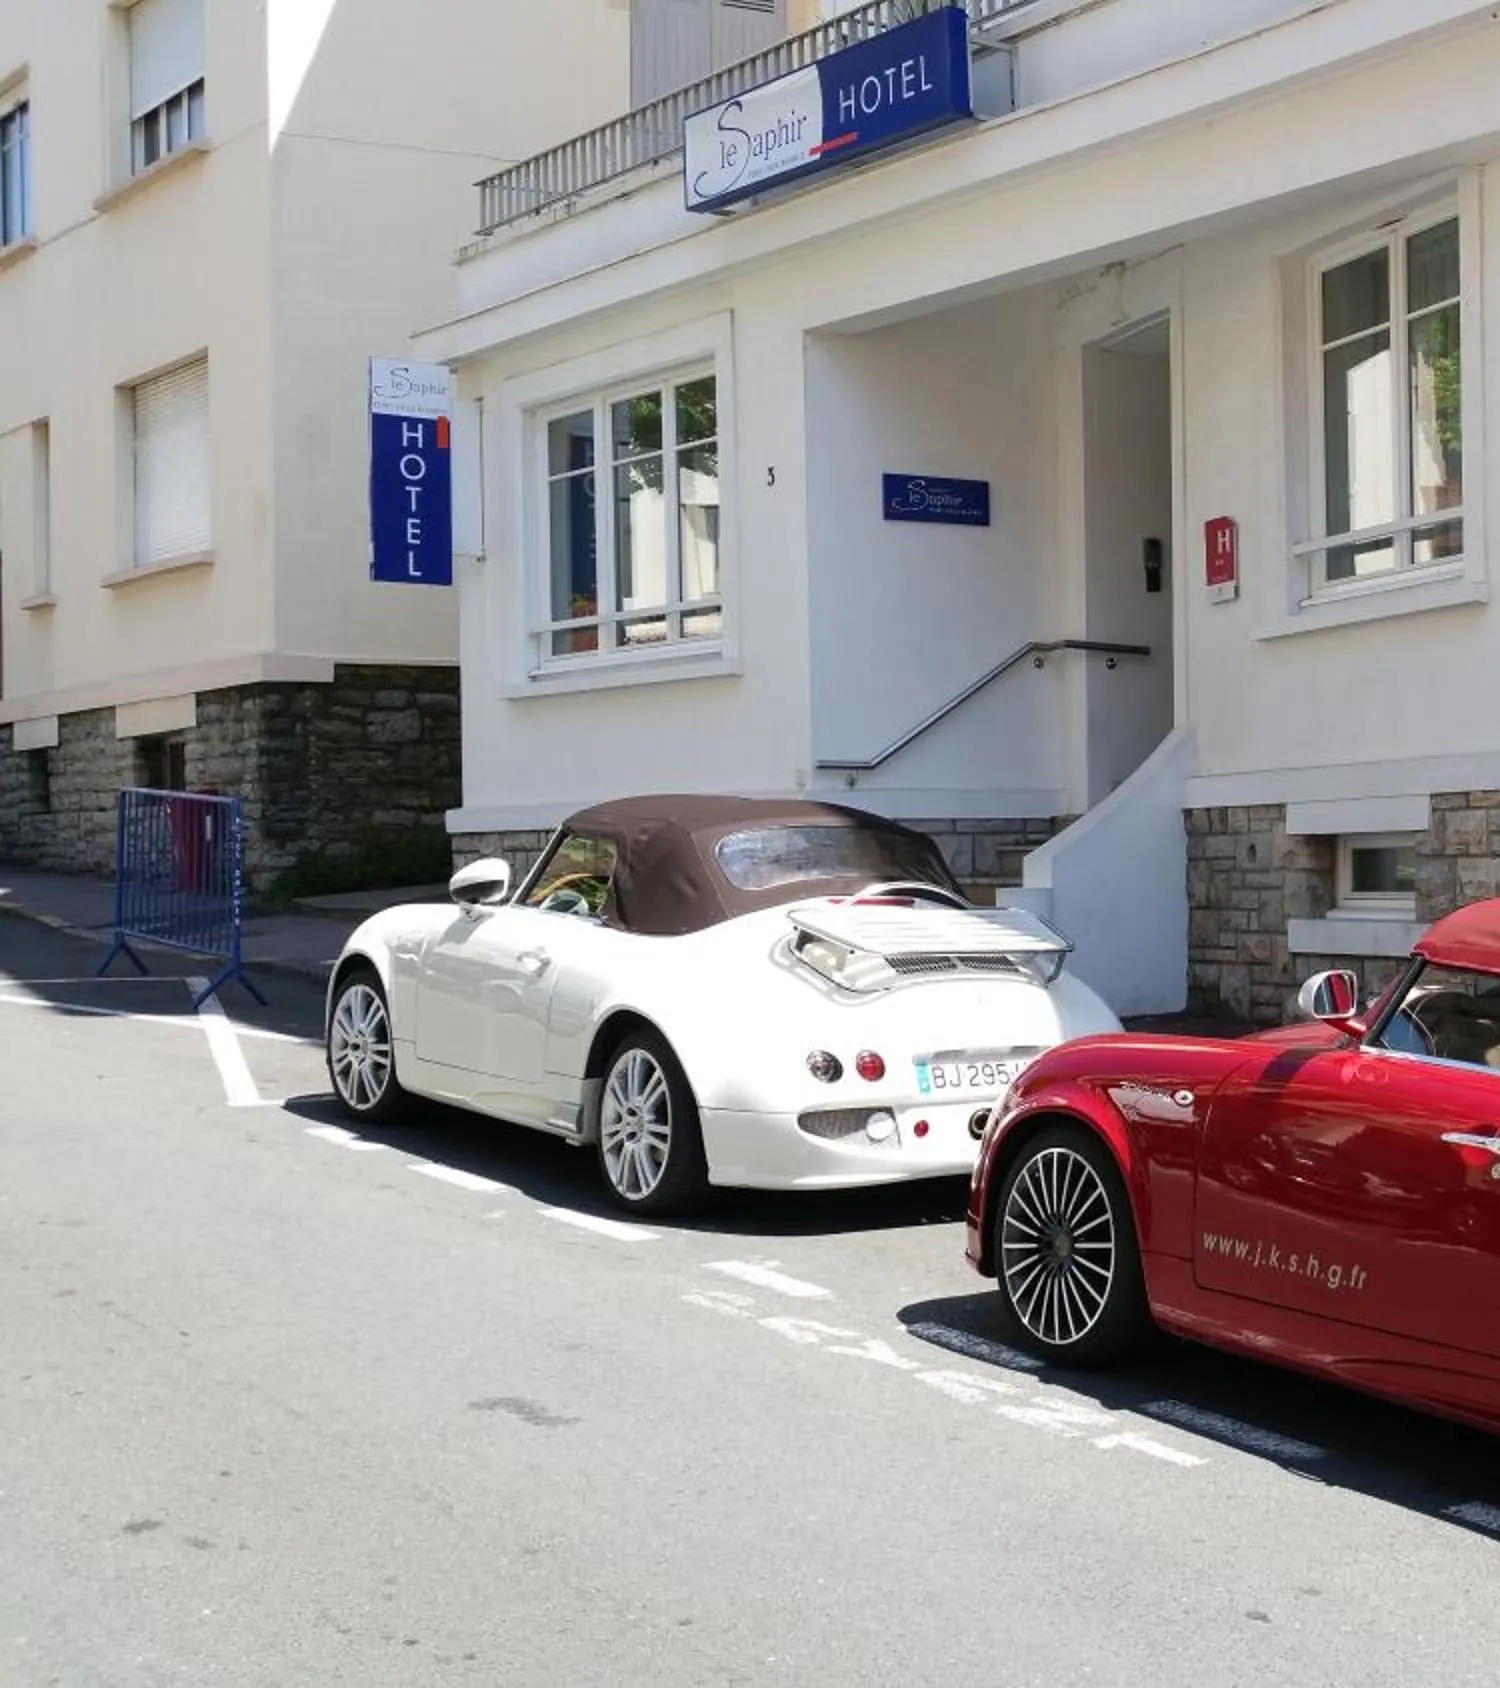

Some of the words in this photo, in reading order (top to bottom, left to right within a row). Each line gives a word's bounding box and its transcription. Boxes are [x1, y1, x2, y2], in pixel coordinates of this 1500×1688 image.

[839, 55, 933, 123] HOTEL
[693, 100, 807, 198] Saphir
[719, 140, 738, 170] le
[399, 421, 426, 577] HOTEL
[1217, 527, 1231, 555] H
[1203, 1232, 1368, 1290] www.j.k.s.h.g.fr
